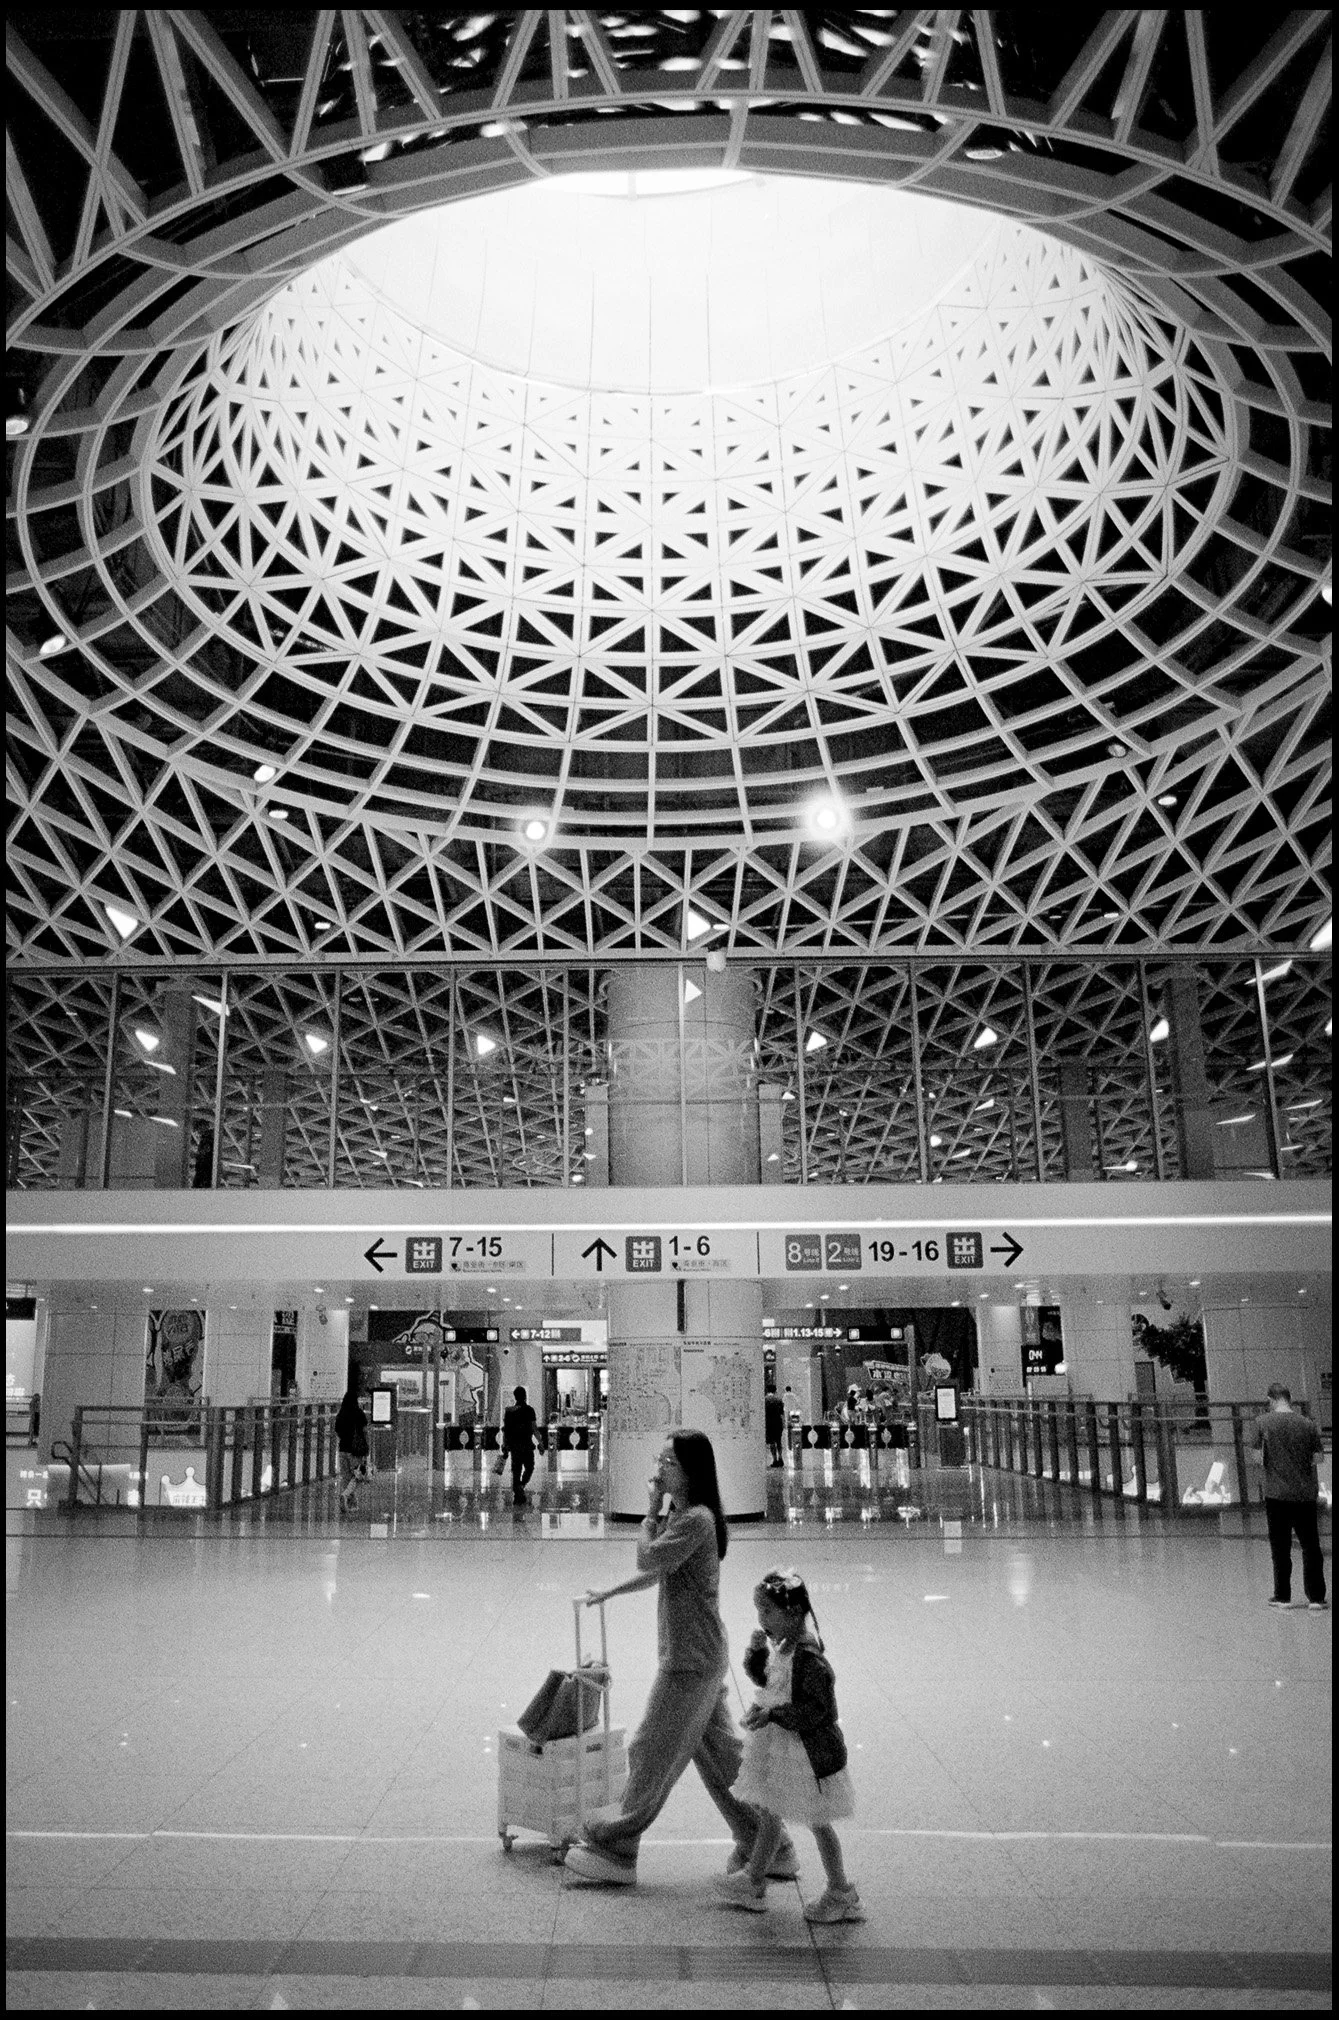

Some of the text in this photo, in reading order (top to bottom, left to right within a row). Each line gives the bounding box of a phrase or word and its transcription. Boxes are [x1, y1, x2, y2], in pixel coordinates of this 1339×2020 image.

[449, 1236, 503, 1257] 7-15
[669, 1235, 711, 1256] 1-6
[788, 1242, 801, 1263] 8
[828, 1242, 842, 1263] 2
[868, 1240, 939, 1262] 19-16
[413, 1260, 435, 1269] EXIT
[632, 1259, 654, 1268] EXIT
[954, 1255, 976, 1264] EXIT
[530, 1329, 551, 1339] 7-12
